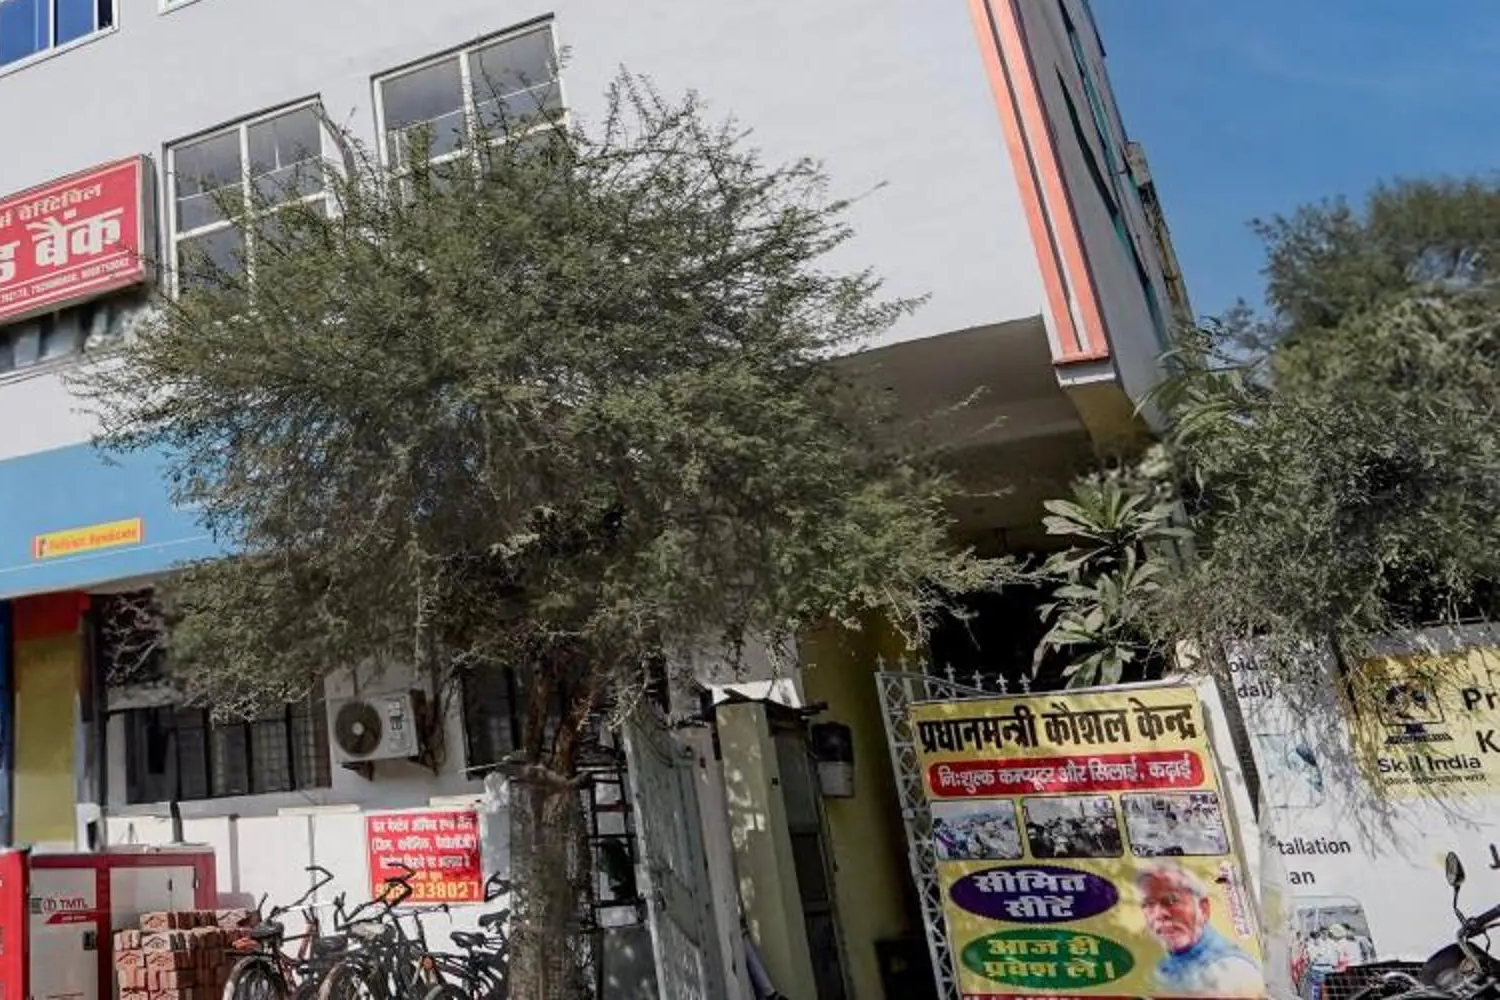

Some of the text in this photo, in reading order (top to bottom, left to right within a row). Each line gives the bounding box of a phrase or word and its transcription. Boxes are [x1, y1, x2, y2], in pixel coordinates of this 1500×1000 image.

[25, 207, 125, 267] बैंक
[917, 697, 1197, 754] प्रधानमन्त्री कौशल केन्द्र
[1058, 761, 1088, 784] और
[1426, 752, 1482, 772] India
[972, 870, 1087, 893] सीमित
[987, 935, 1100, 956] आज ही
